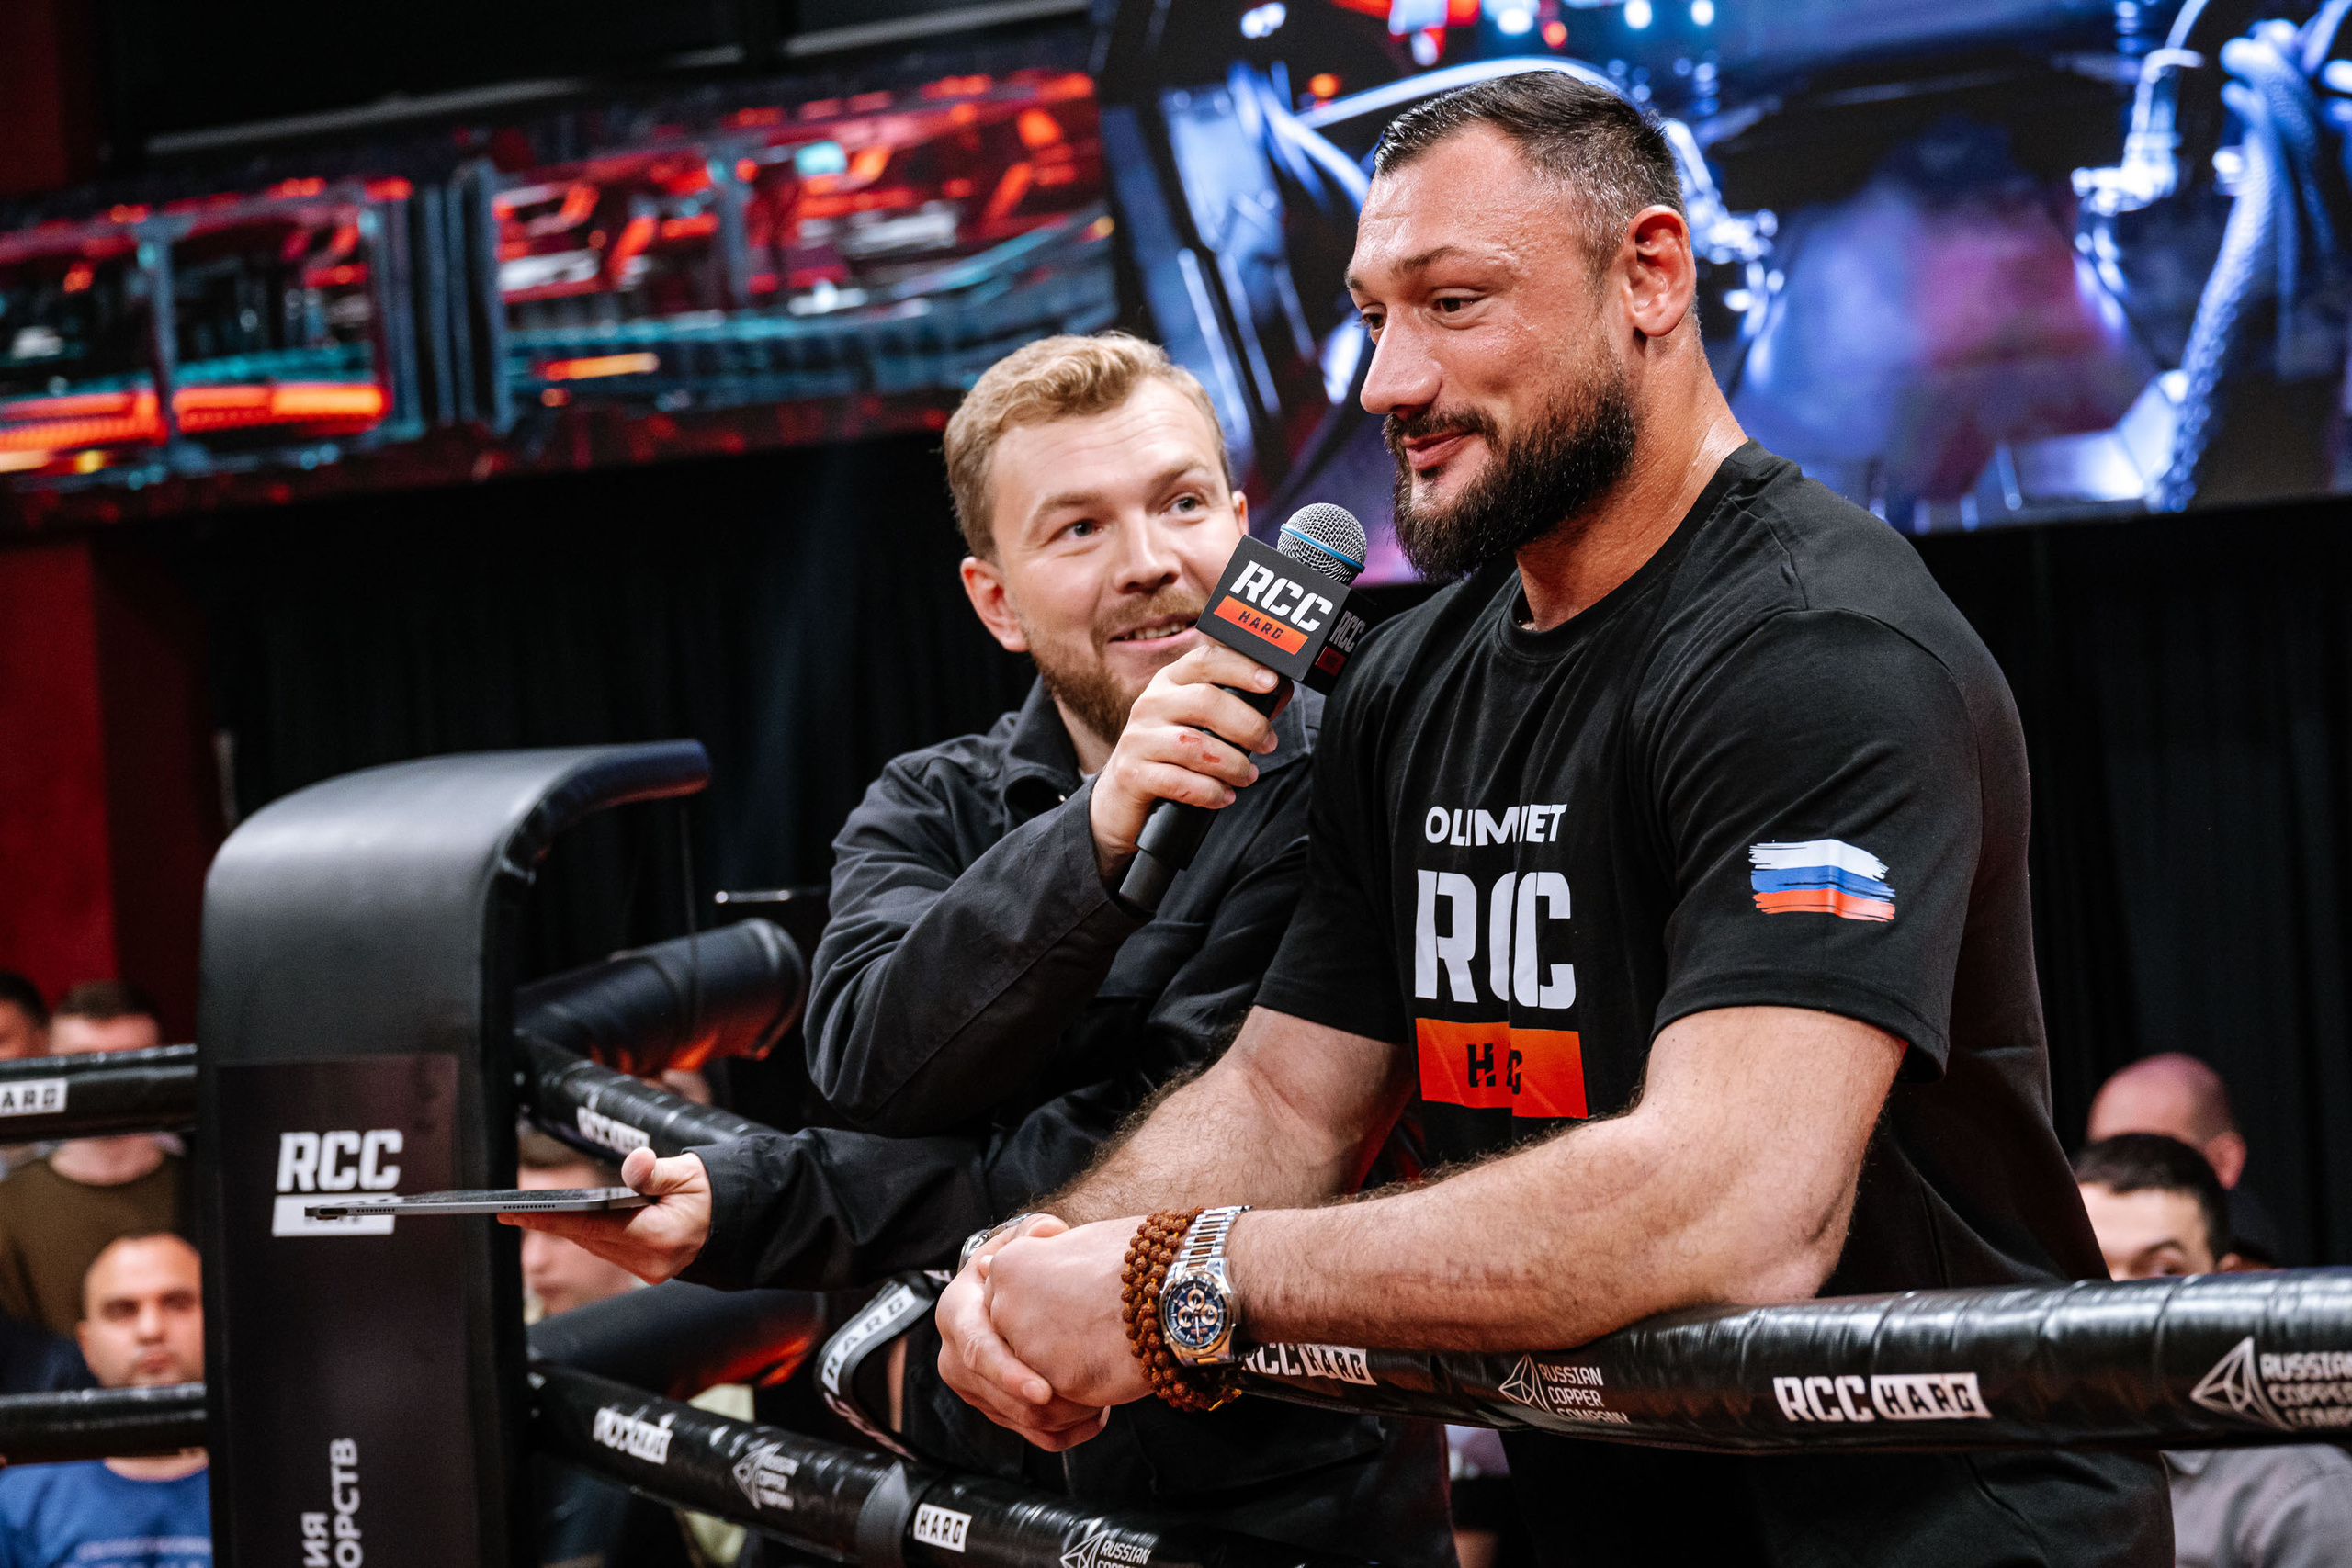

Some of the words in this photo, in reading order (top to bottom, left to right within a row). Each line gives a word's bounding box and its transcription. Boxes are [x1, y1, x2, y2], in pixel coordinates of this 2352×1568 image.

[1229, 559, 1333, 632] RCC
[1329, 610, 1366, 653] RCC
[277, 1129, 404, 1192] RCC
[1538, 1362, 1604, 1386] RUSSIAN
[1547, 1386, 1605, 1407] COPPER
[1773, 1375, 1875, 1422] RCC
[1100, 1540, 1152, 1565] RUSSIAN
